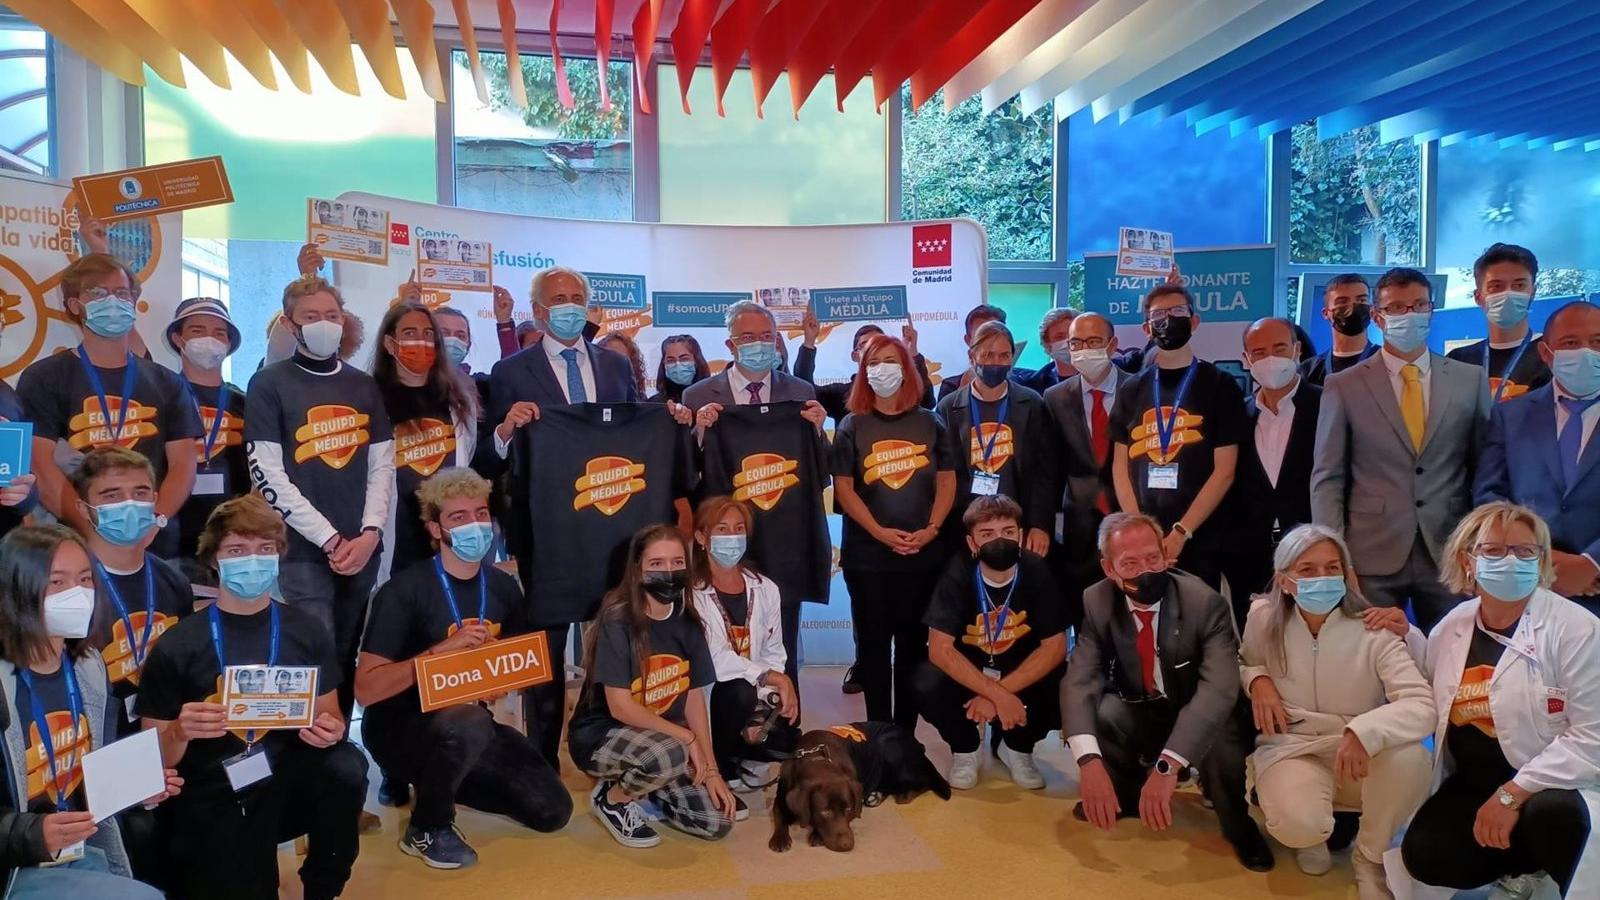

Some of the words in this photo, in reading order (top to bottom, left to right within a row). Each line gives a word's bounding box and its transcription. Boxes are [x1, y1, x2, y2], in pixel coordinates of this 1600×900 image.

[2, 226, 20, 247] la
[28, 231, 73, 252] vida
[492, 249, 555, 269] sfusión
[912, 268, 952, 276] Comunidad
[925, 275, 952, 283] Madrid
[1180, 272, 1251, 287] ONANTE
[591, 279, 636, 289] DONANTE
[590, 287, 636, 303] ÉDULA
[852, 294, 861, 303] al
[862, 293, 893, 304] Equipo
[667, 302, 731, 314] #somosUP
[830, 302, 889, 317] MÉDULA
[1109, 302, 1129, 314] DE
[313, 415, 356, 435] EQUIPO
[314, 433, 359, 454] MÉDULA
[401, 426, 443, 447] EQUIPO
[404, 441, 447, 462] MÉDULA
[876, 447, 912, 462] EQUIPO
[589, 466, 630, 485] EQUIPO
[746, 463, 783, 481] EQUIPO
[877, 459, 915, 476] MÉDULA
[590, 480, 632, 500] MÉDULA
[747, 477, 785, 497] MÉDULA
[432, 669, 483, 691] Dona
[485, 649, 540, 677] VIDA
